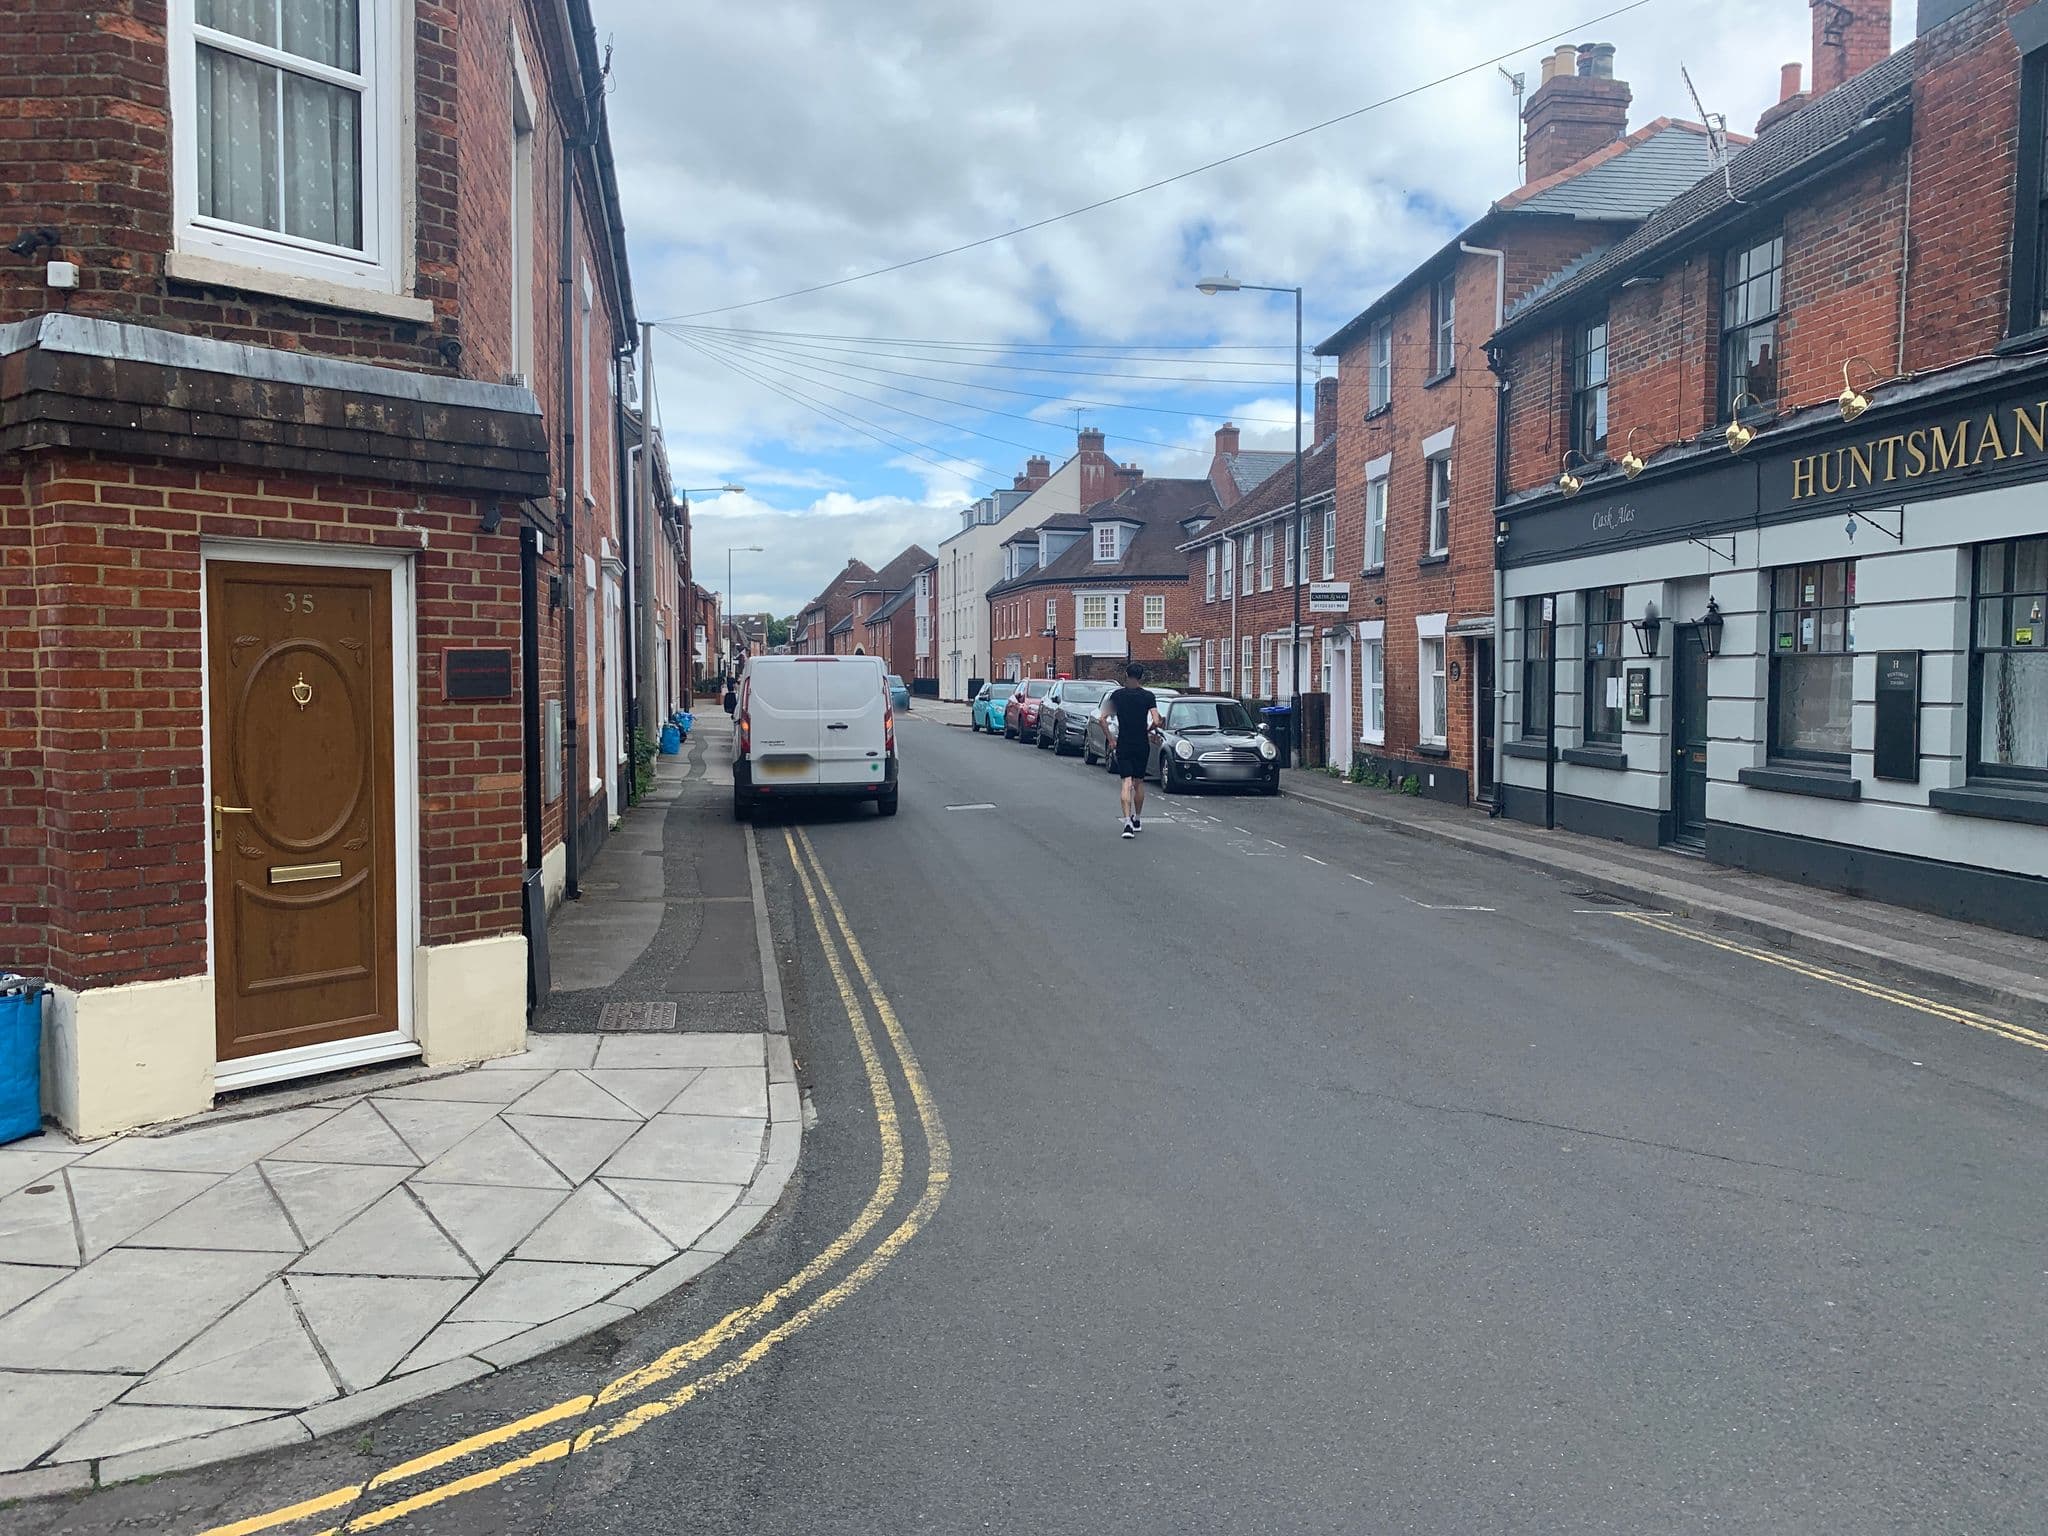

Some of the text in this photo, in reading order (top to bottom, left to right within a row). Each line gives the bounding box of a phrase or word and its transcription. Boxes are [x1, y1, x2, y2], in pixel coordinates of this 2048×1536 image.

[1791, 401, 2048, 500] HUNTSMAN
[1592, 503, 1636, 530] Cask Ales
[283, 592, 314, 614] 35
[1893, 660, 1899, 669] H
